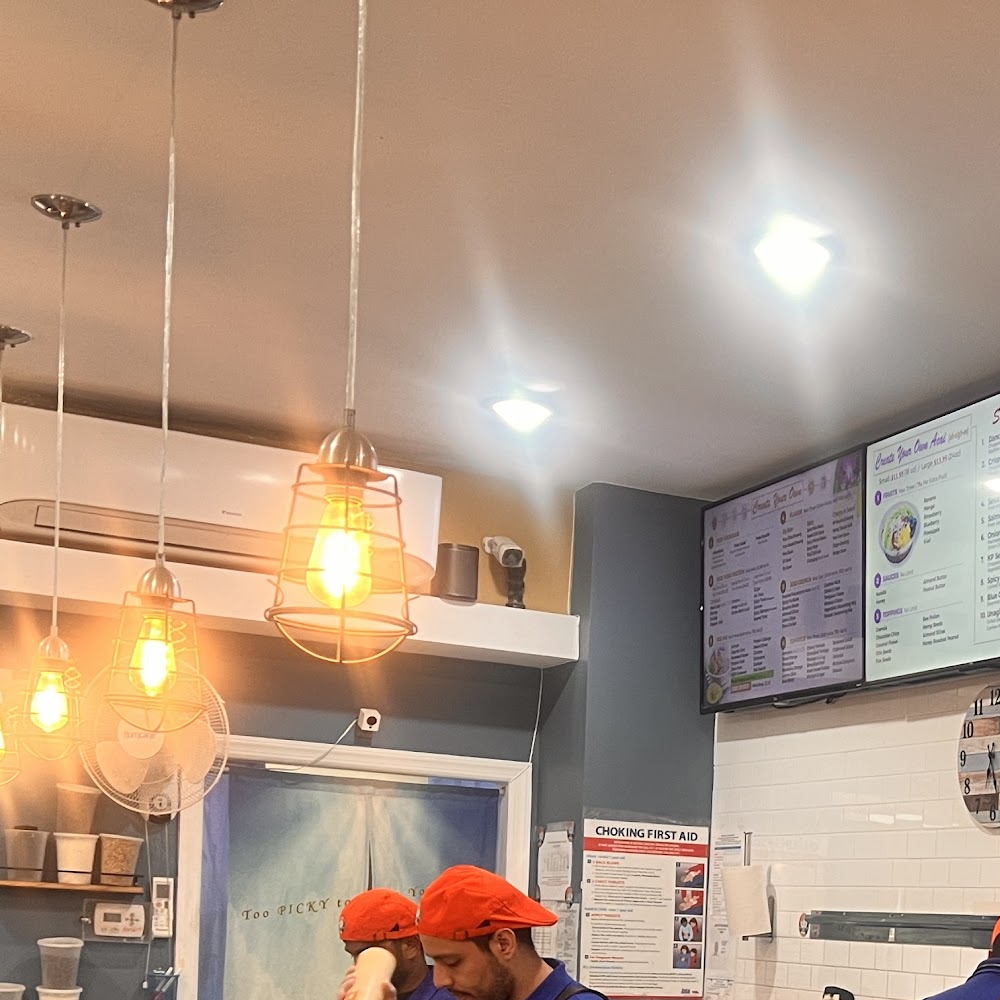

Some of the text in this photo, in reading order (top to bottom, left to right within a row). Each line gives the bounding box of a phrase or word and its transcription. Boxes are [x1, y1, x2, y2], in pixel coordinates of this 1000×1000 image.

[876, 453, 894, 470] Create
[897, 446, 911, 463] Your
[914, 439, 928, 453] Own
[930, 432, 946, 449] Acai
[987, 574, 1000, 584] Spicy
[990, 688, 1000, 706] 12
[974, 699, 983, 716] 11
[963, 721, 973, 738] 10
[960, 750, 966, 767] 9
[964, 778, 970, 795] 8
[975, 798, 980, 814] 7
[990, 805, 996, 821] 6
[596, 826, 698, 841] CHOKING FIRST AID
[408, 887, 425, 897] Yo
[242, 898, 350, 920] Too PICKY to
